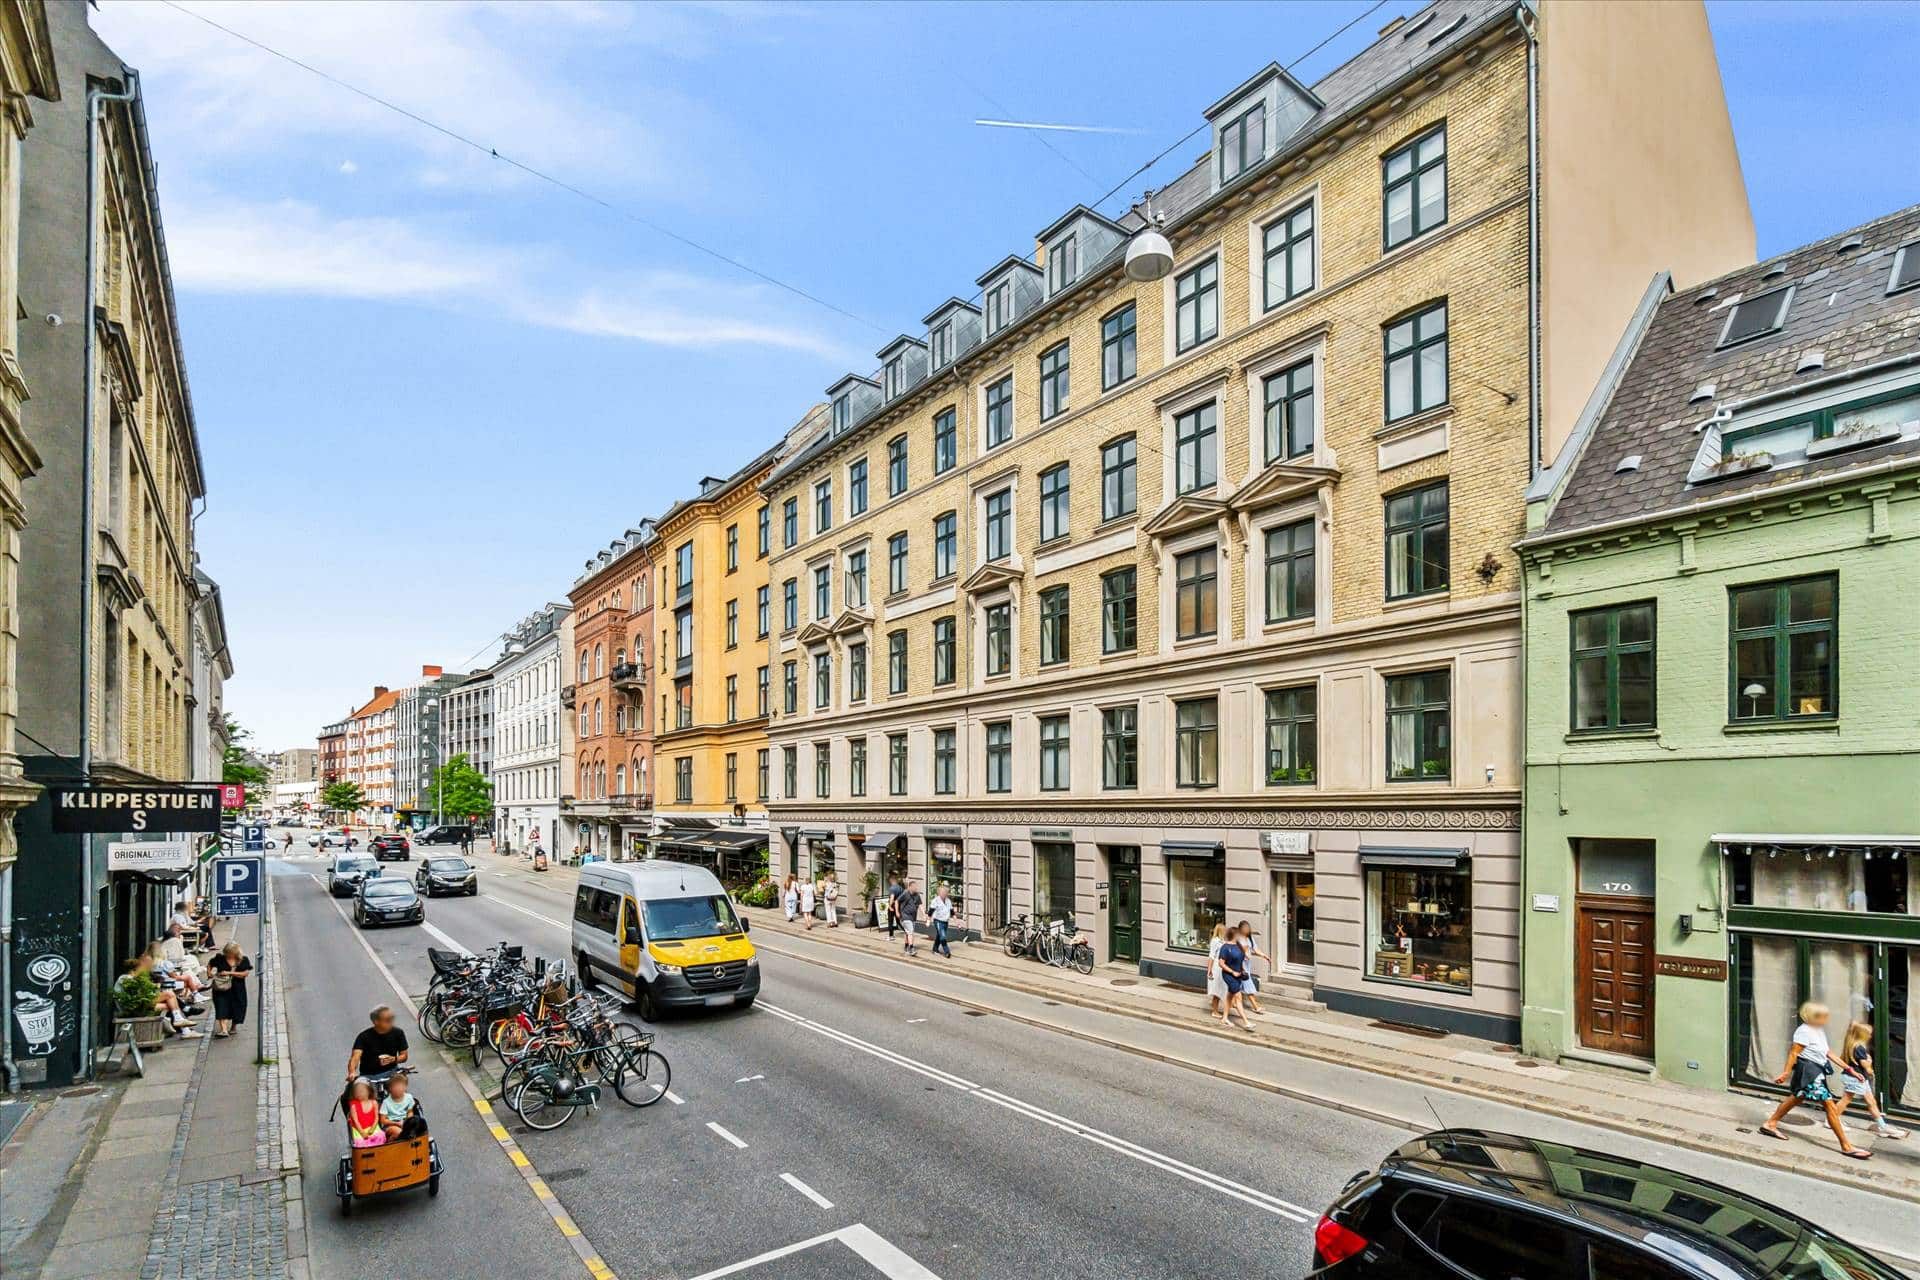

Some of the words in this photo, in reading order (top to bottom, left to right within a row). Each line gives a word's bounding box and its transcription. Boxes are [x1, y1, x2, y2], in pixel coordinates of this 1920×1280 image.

[61, 792, 213, 809] KLIPPESTUEN
[132, 809, 147, 831] S
[248, 827, 260, 840] P
[114, 850, 152, 860] ORIGINAL
[225, 863, 250, 892] P
[1602, 882, 1632, 892] 170
[1658, 961, 1720, 975] restaurant
